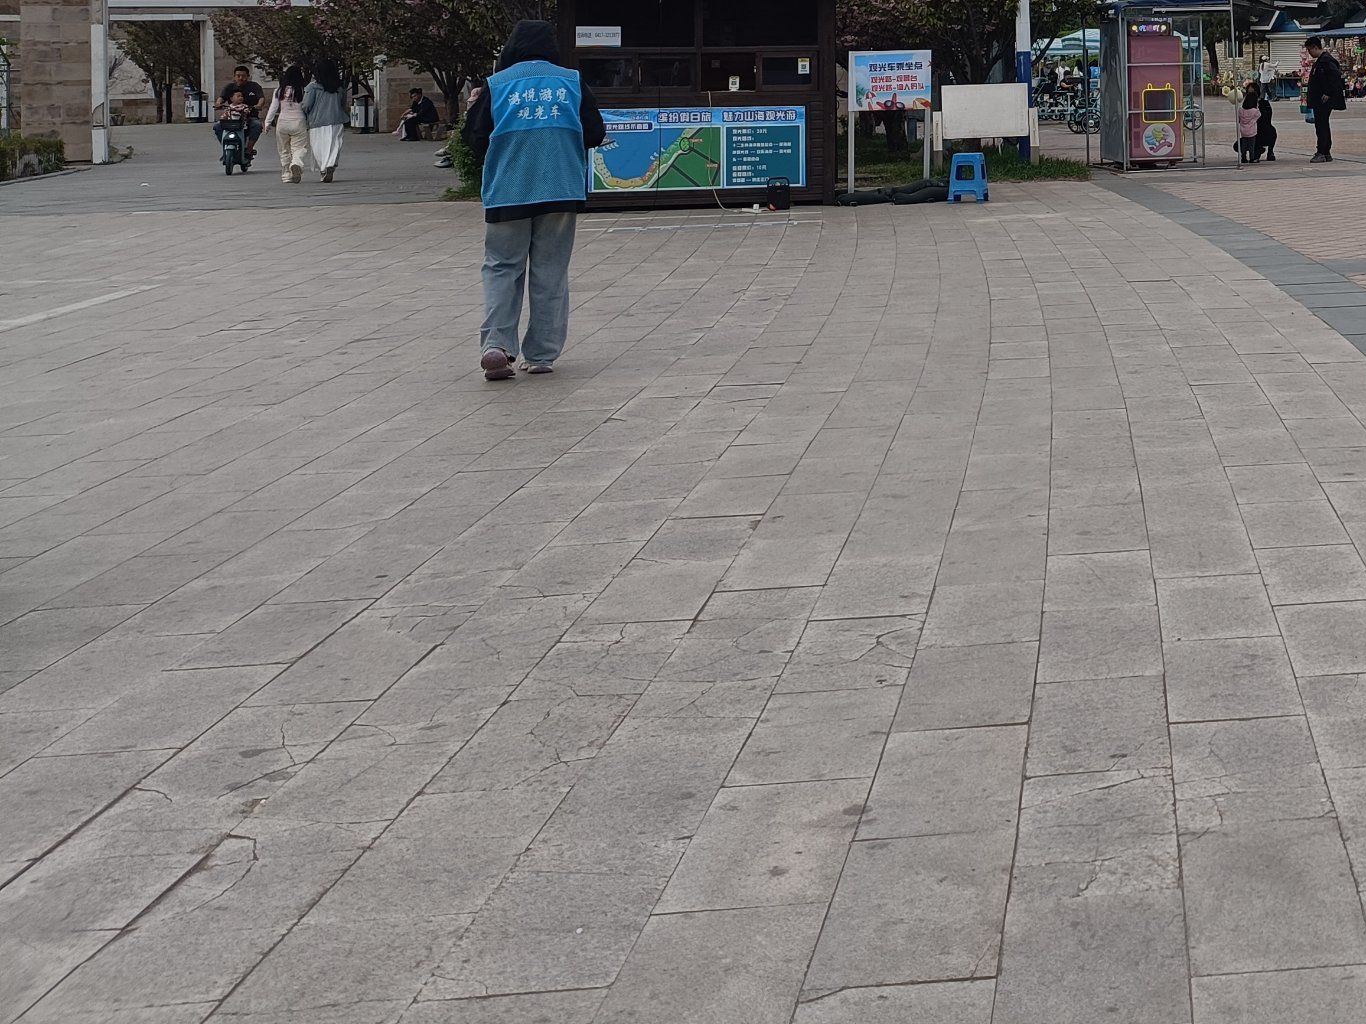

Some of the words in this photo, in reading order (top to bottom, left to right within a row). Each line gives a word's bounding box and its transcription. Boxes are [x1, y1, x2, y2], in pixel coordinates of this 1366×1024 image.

[869, 62, 923, 72] 观光车乘坐点
[517, 104, 561, 120] 观光车
[723, 110, 797, 122] 魅力山海观光游
